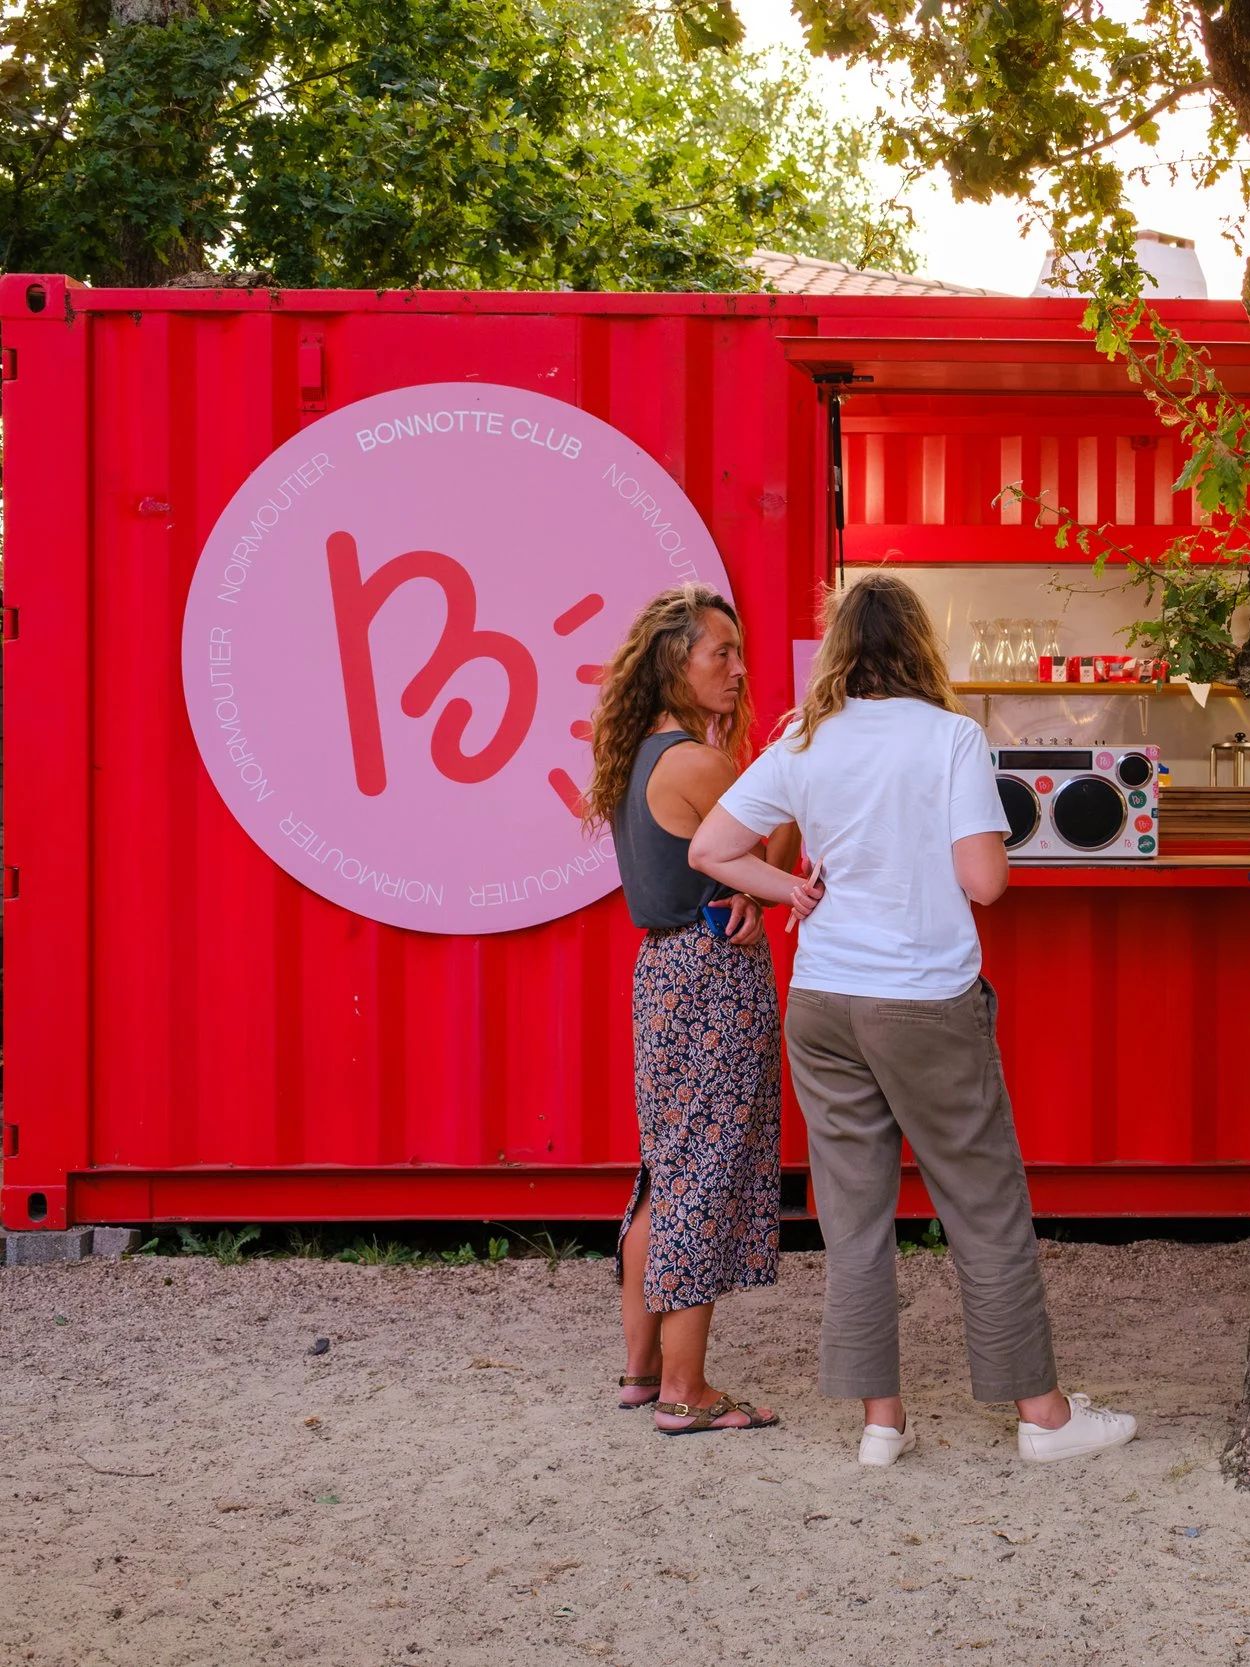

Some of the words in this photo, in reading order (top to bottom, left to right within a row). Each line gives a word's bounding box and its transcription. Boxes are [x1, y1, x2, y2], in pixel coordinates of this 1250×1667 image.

[356, 411, 505, 452] BONNOTTE
[511, 418, 583, 460] CLUB
[217, 452, 336, 604] NOIRMOUTIER
[601, 463, 699, 580] NOIRMOUT
[209, 626, 275, 802] NOIRMOUTIER
[279, 811, 444, 906] NOIRMOUTIER
[468, 836, 617, 906] OIRMOUTIER
